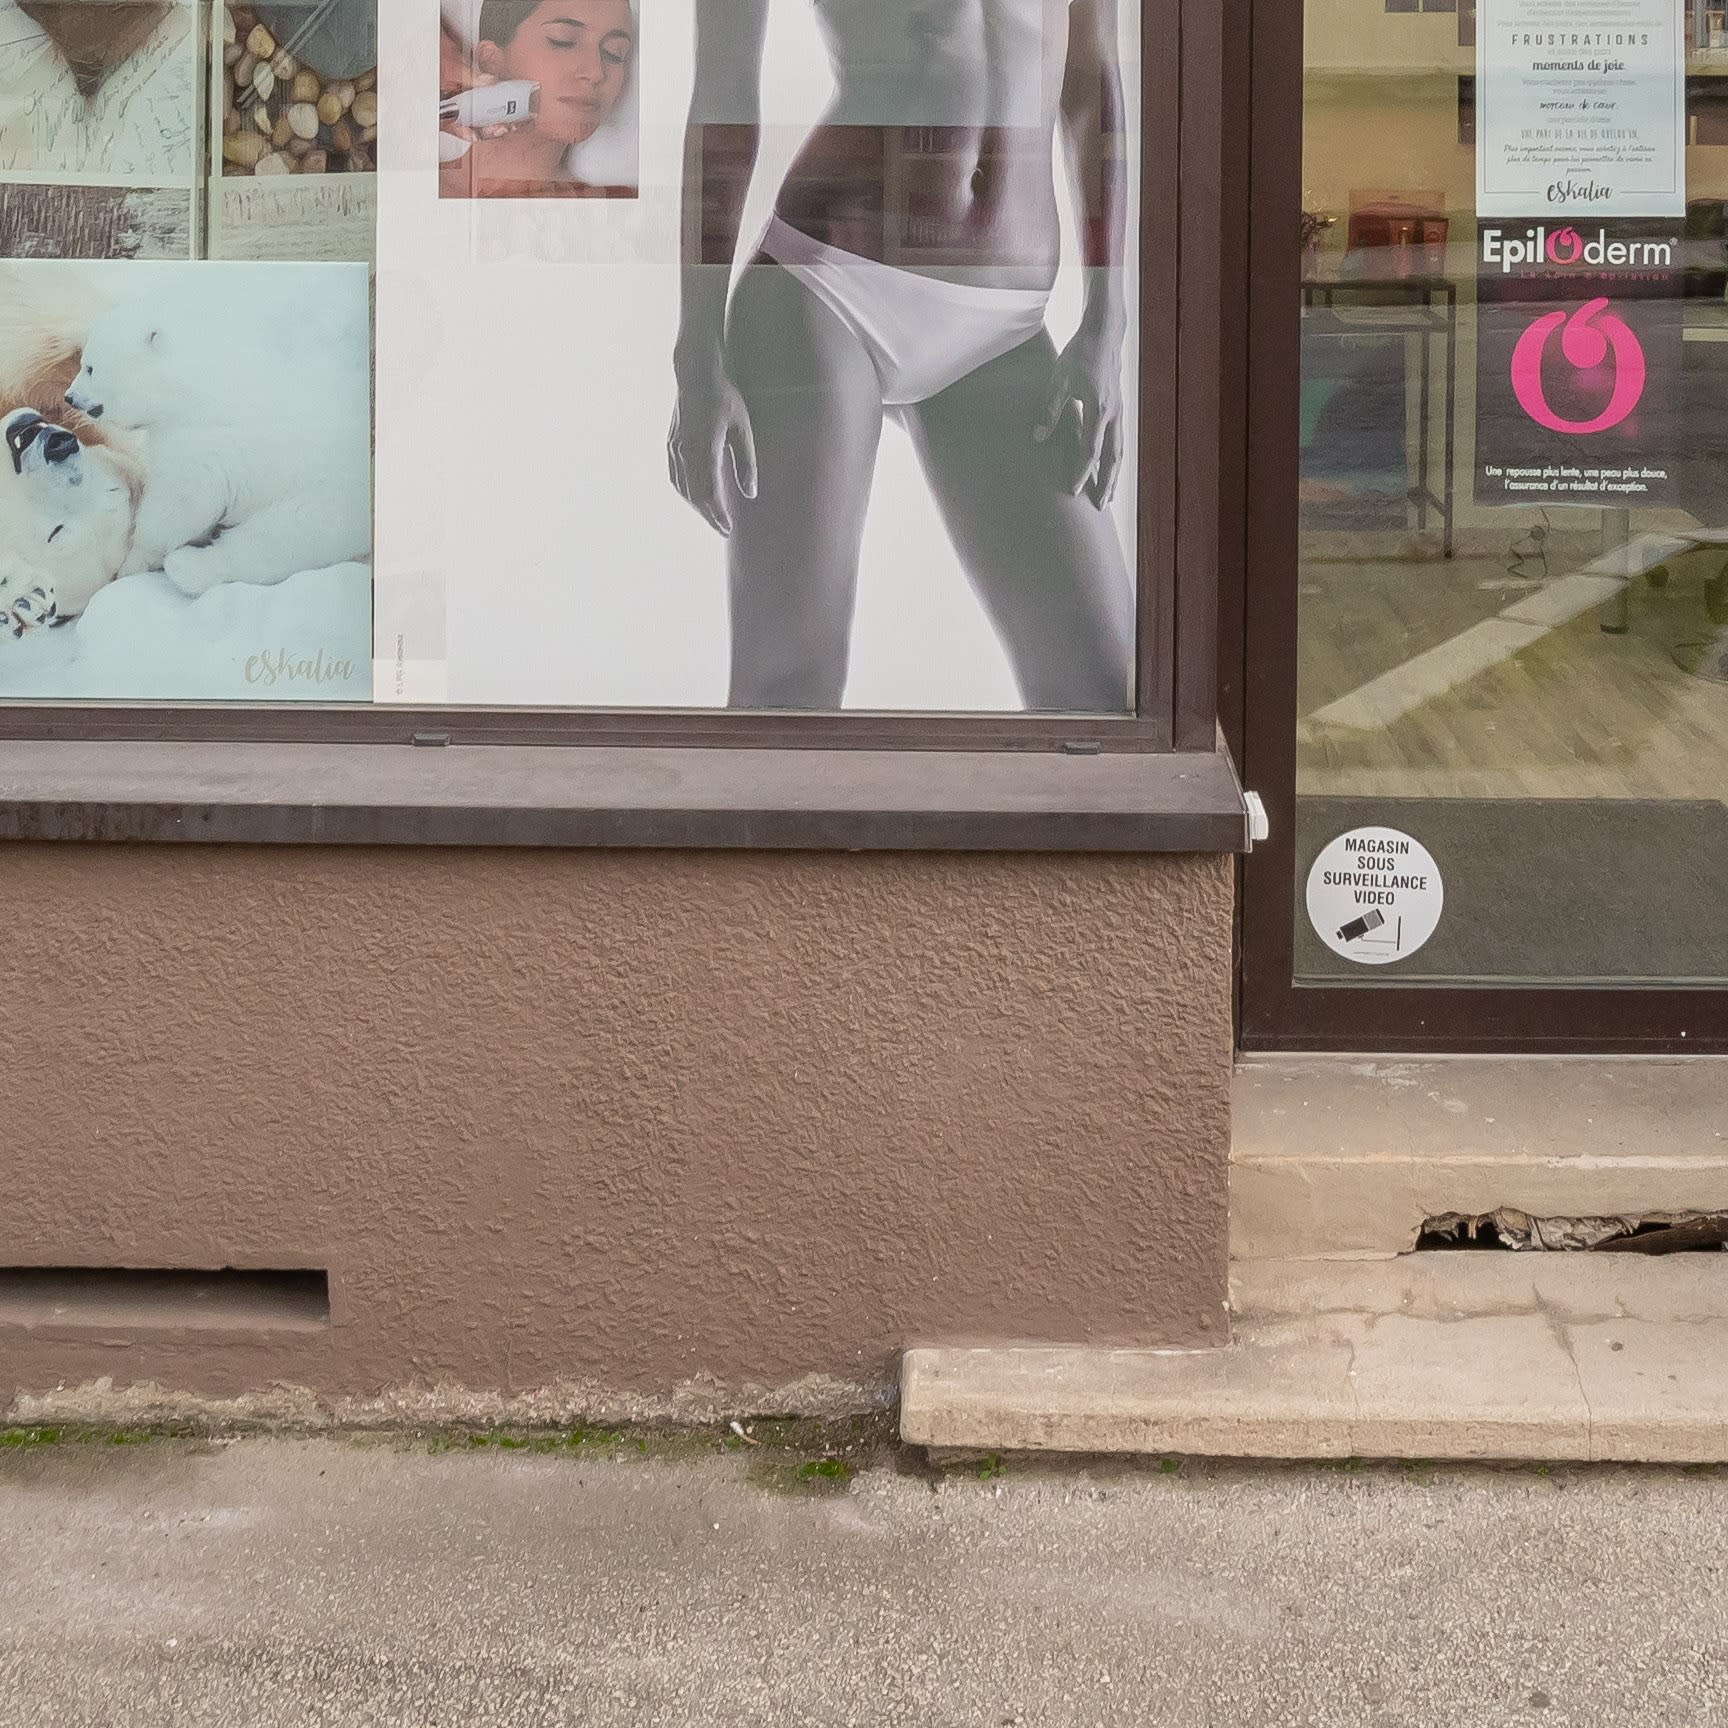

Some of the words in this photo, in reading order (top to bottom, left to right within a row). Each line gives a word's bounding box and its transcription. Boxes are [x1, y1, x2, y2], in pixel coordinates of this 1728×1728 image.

[1512, 34, 1649, 46] FRUSTRATIONS
[1533, 60, 1584, 71] moments
[1587, 59, 1601, 71] de
[1345, 838, 1409, 854] MAGASIN
[1357, 856, 1394, 871] SOUS
[1324, 871, 1427, 890] SURVEILLANCE
[1354, 890, 1394, 905] VIDEO
